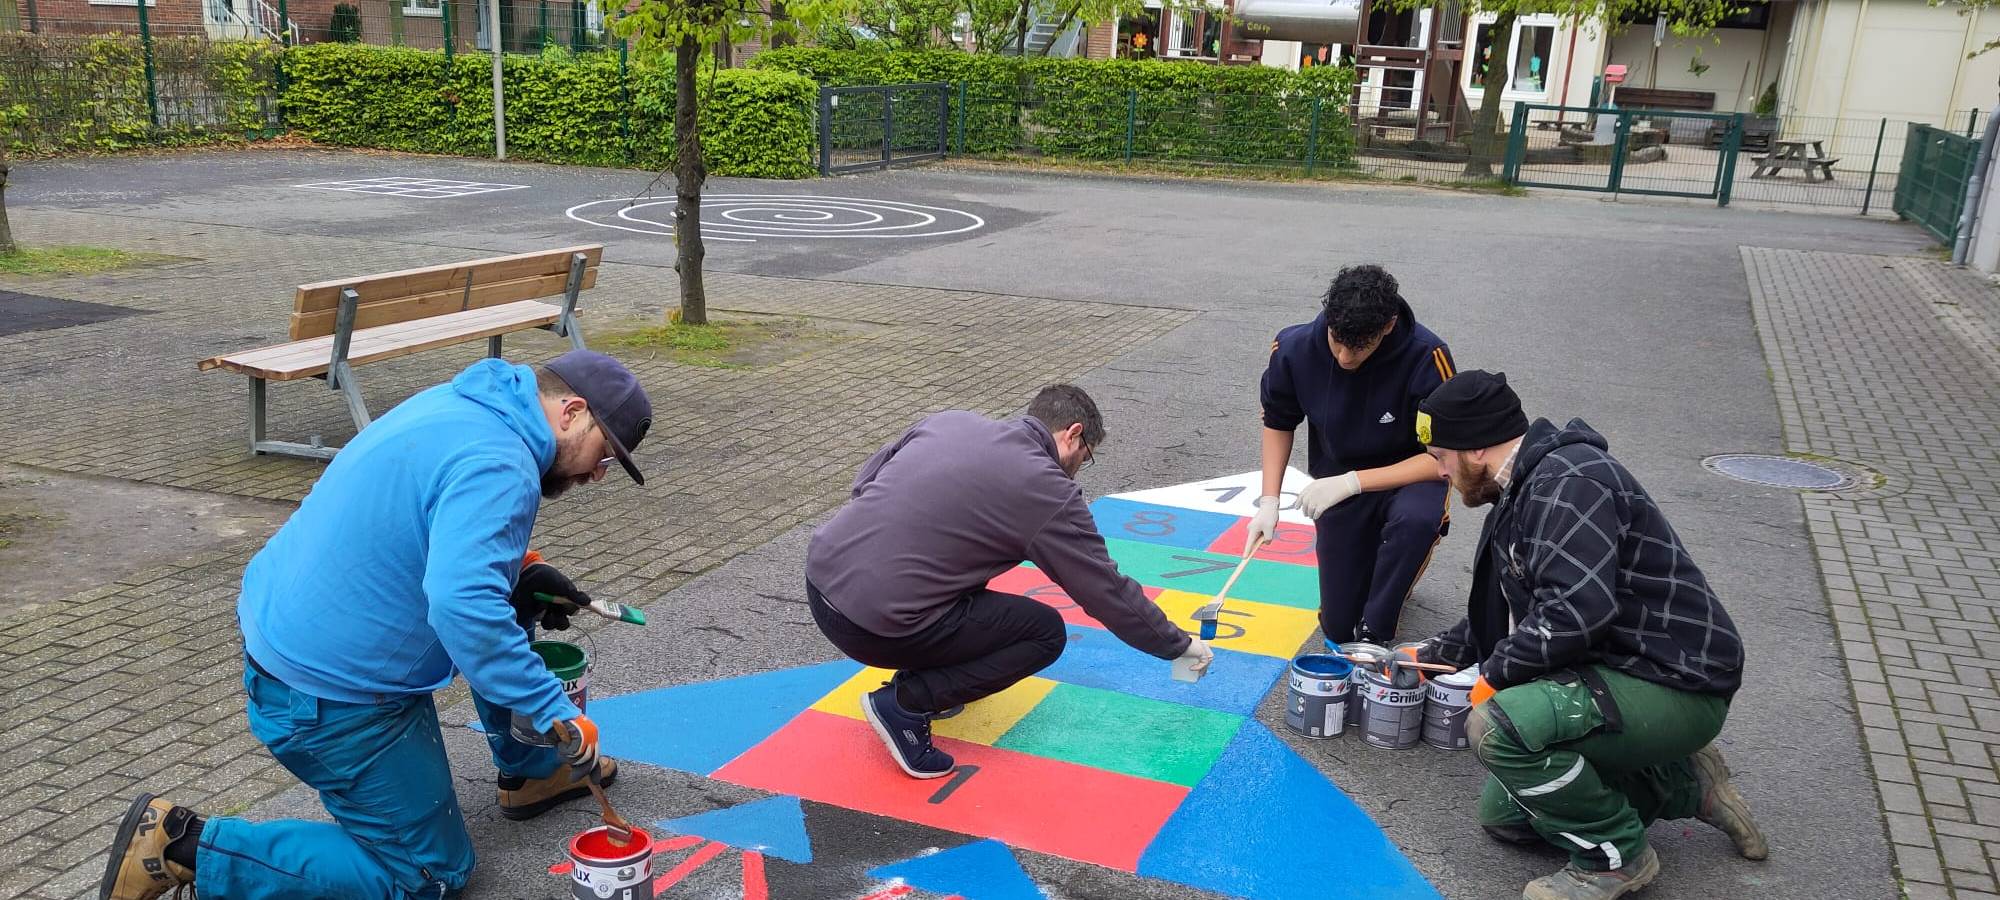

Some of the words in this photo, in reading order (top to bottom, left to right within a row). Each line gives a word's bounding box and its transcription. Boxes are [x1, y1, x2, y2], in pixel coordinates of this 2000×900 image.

[1124, 510, 1177, 536] 8
[1160, 554, 1239, 579] 7
[927, 764, 981, 804] 1
